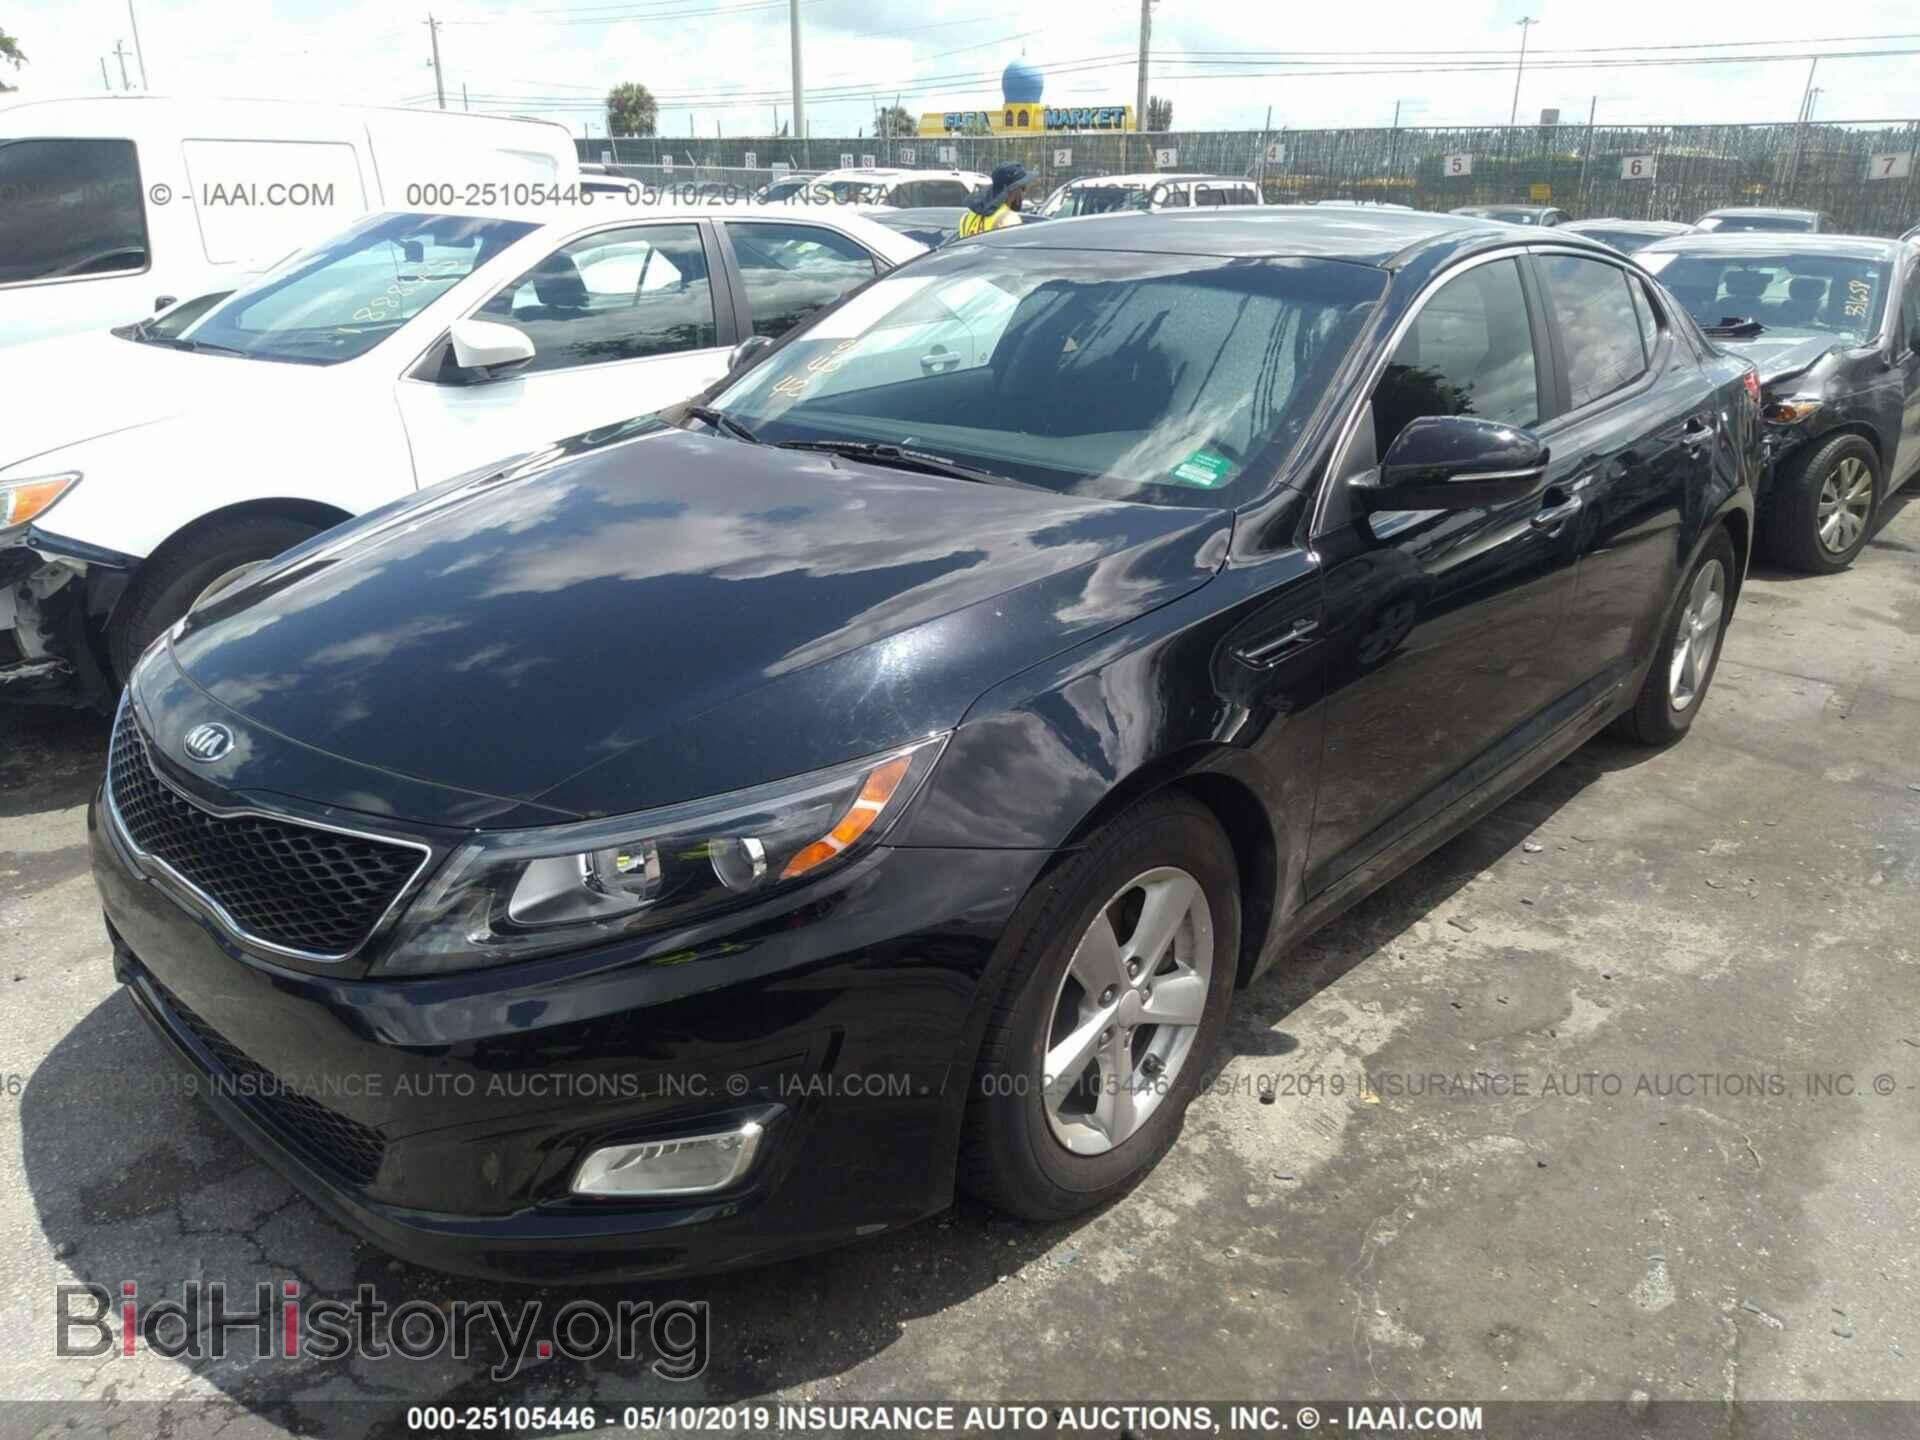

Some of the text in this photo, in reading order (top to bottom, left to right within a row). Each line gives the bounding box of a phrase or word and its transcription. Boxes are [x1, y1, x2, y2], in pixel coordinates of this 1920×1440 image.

[1044, 105, 1125, 129] MARKET
[1058, 152, 1067, 164] 2
[1161, 151, 1170, 164] 3
[1268, 146, 1277, 160] 4
[1452, 158, 1462, 173] 5
[1631, 160, 1642, 176] 6
[1883, 157, 1897, 175] 7
